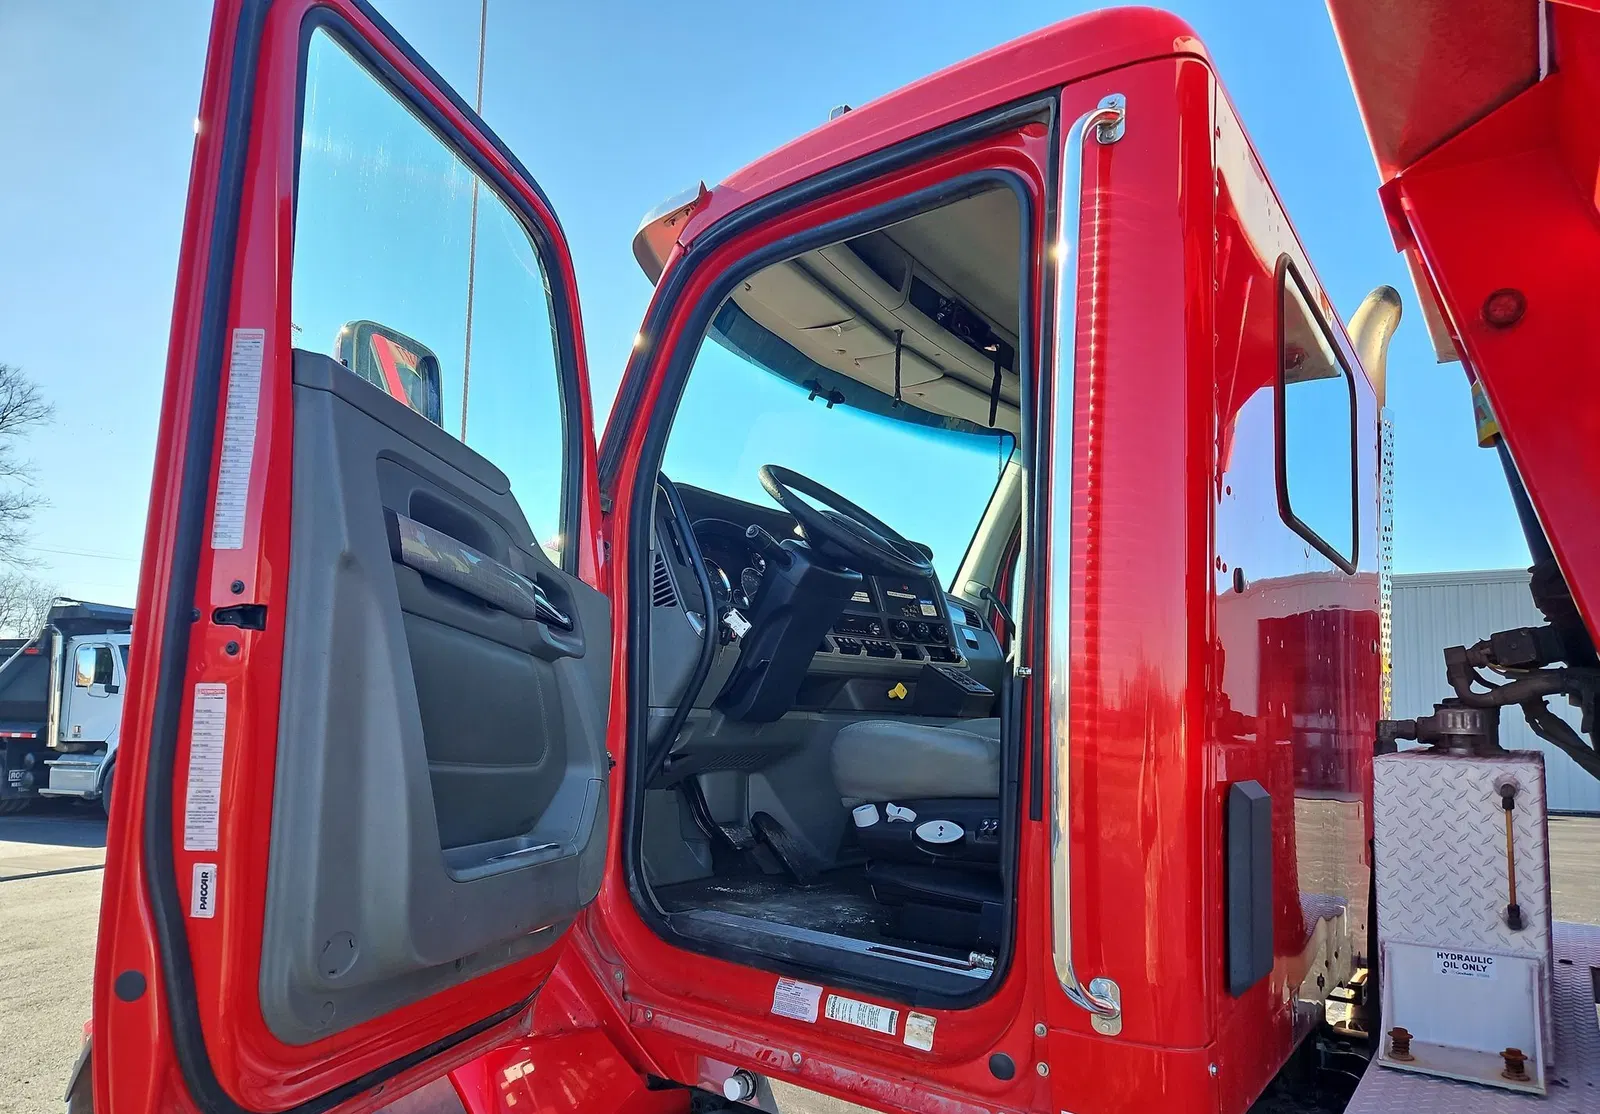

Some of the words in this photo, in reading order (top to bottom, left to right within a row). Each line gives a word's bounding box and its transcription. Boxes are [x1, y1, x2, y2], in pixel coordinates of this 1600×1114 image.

[200, 871, 209, 910] PACCAR
[1436, 952, 1493, 964] HYDRAULIC
[1443, 960, 1459, 969] OIL
[1461, 963, 1488, 972] ONLY
